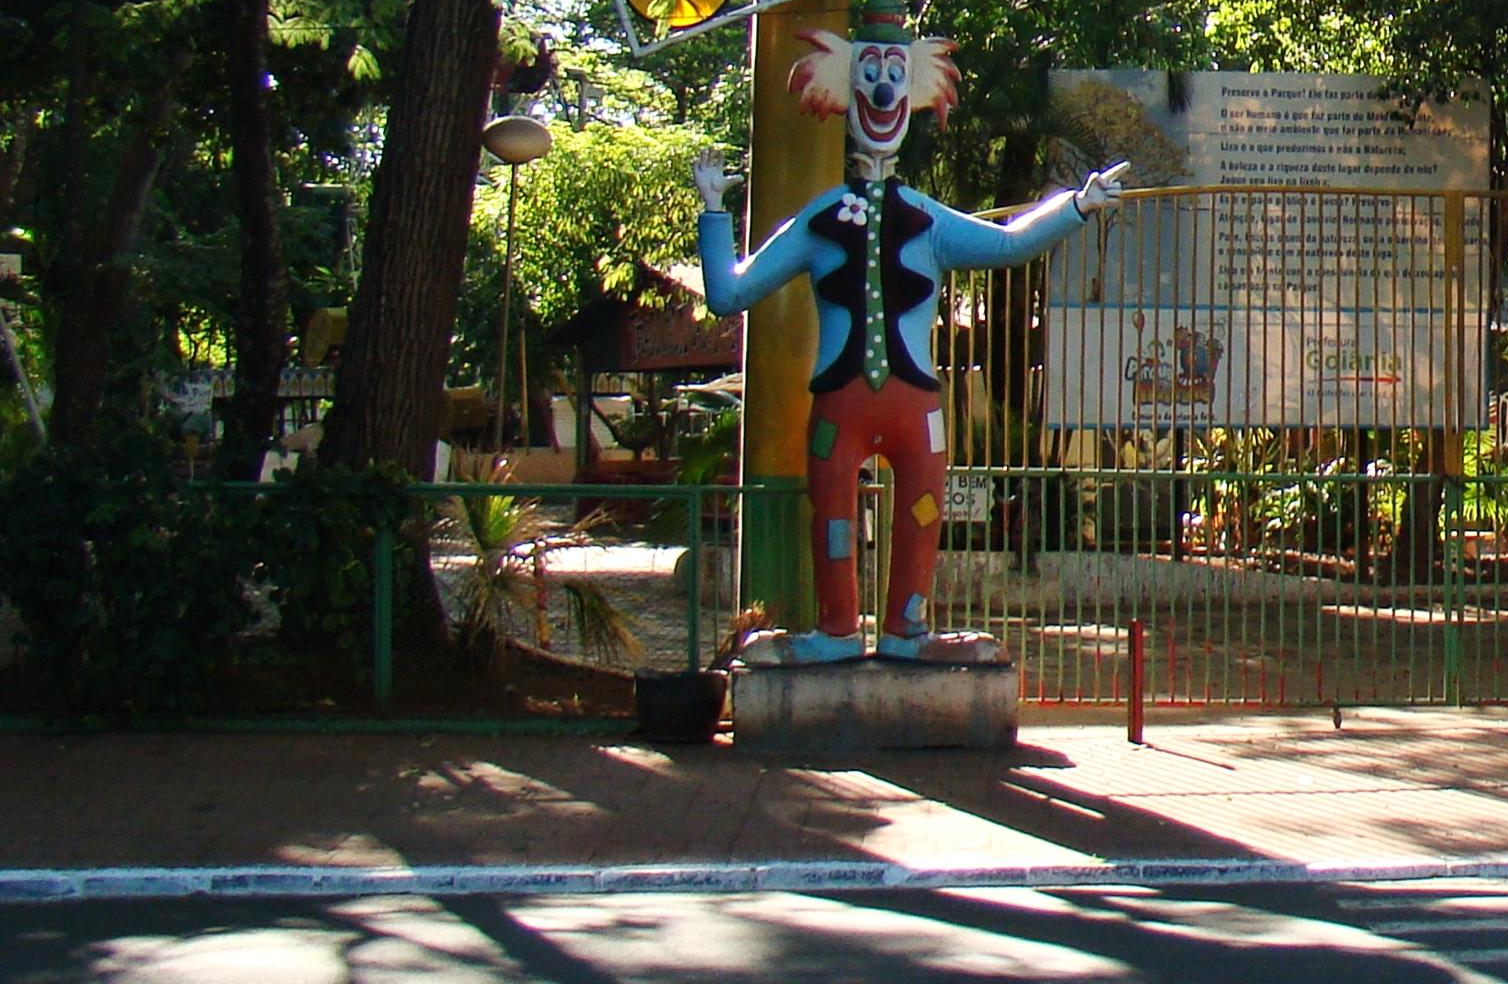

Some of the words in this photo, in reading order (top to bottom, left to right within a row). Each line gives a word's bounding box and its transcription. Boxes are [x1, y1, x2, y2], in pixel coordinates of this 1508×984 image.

[1221, 86, 1260, 97] Preserve
[1325, 89, 1338, 99] faz
[1311, 111, 1325, 121] faz
[1327, 112, 1350, 123] parte
